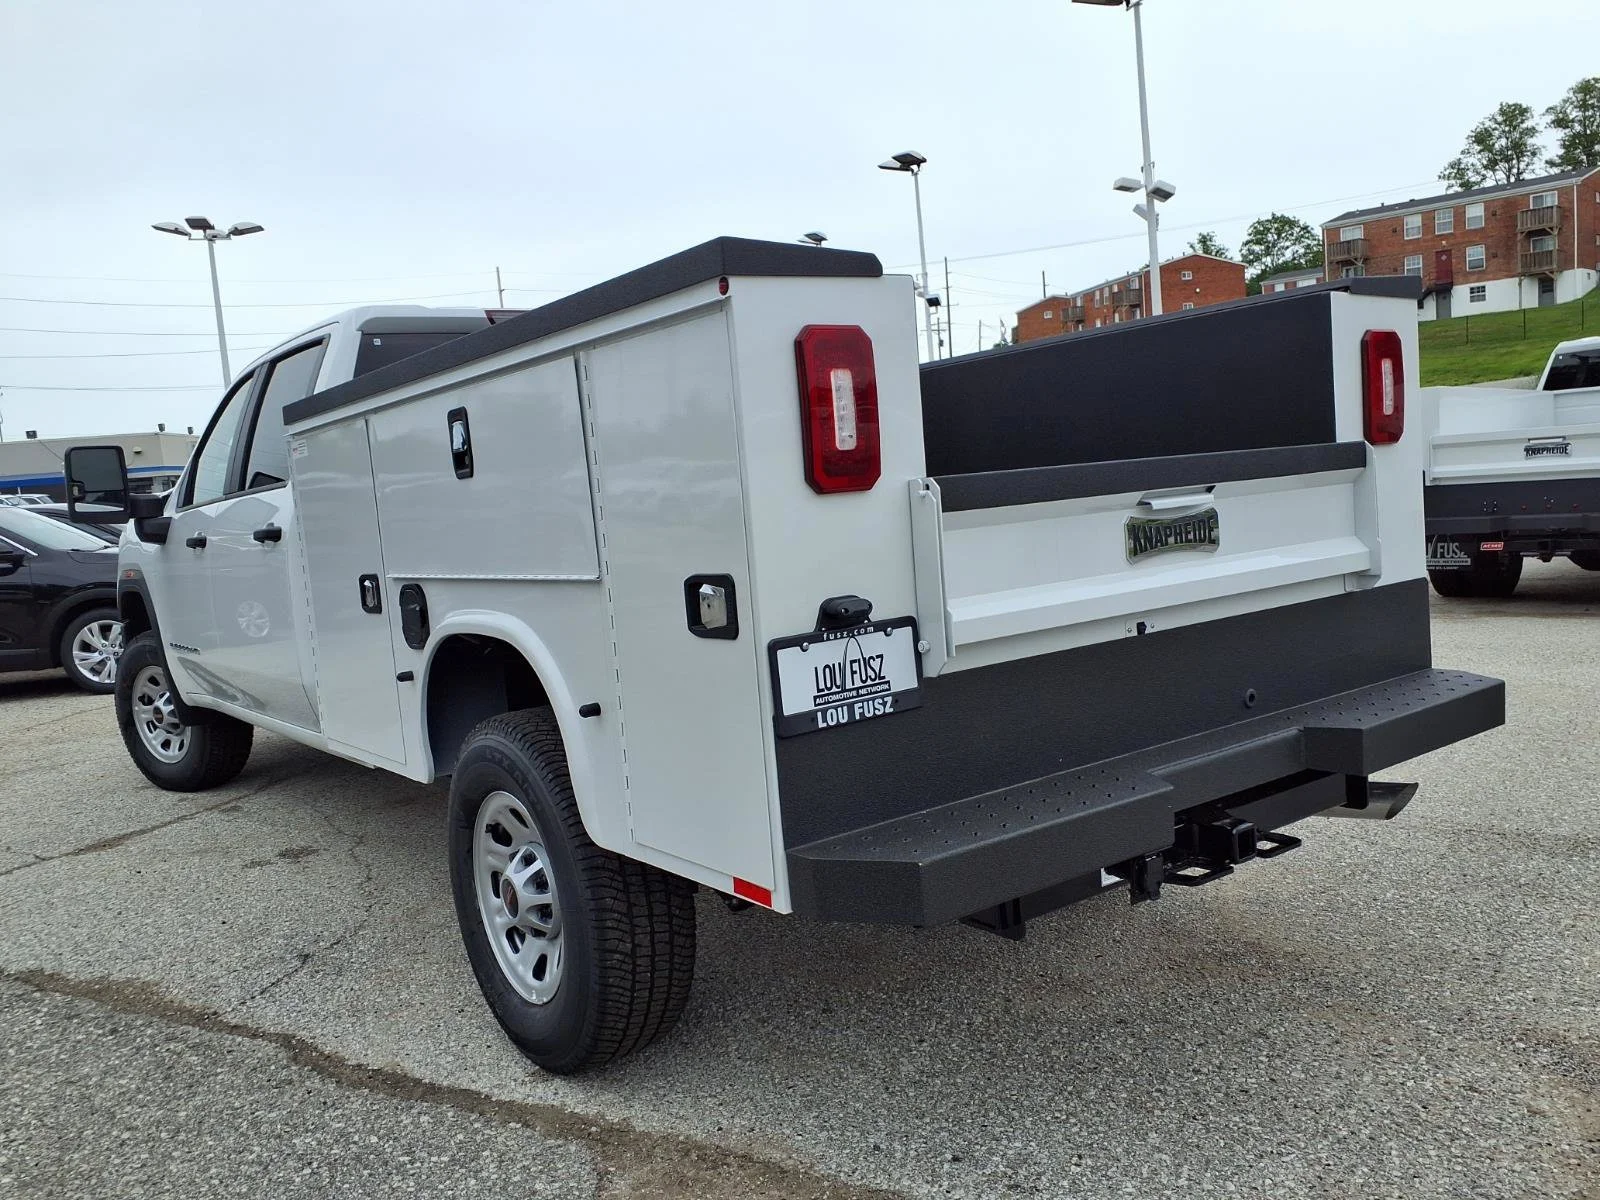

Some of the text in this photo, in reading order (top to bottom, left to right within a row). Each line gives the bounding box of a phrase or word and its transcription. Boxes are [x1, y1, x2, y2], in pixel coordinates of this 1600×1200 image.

[1129, 519, 1216, 557] KNAPHEIDE
[823, 626, 874, 641] fusz.com
[815, 654, 886, 693] LOU FUSZ
[815, 683, 890, 704] AUTOMOTIVE NETWORK
[816, 696, 894, 728] LOU FUSZ
